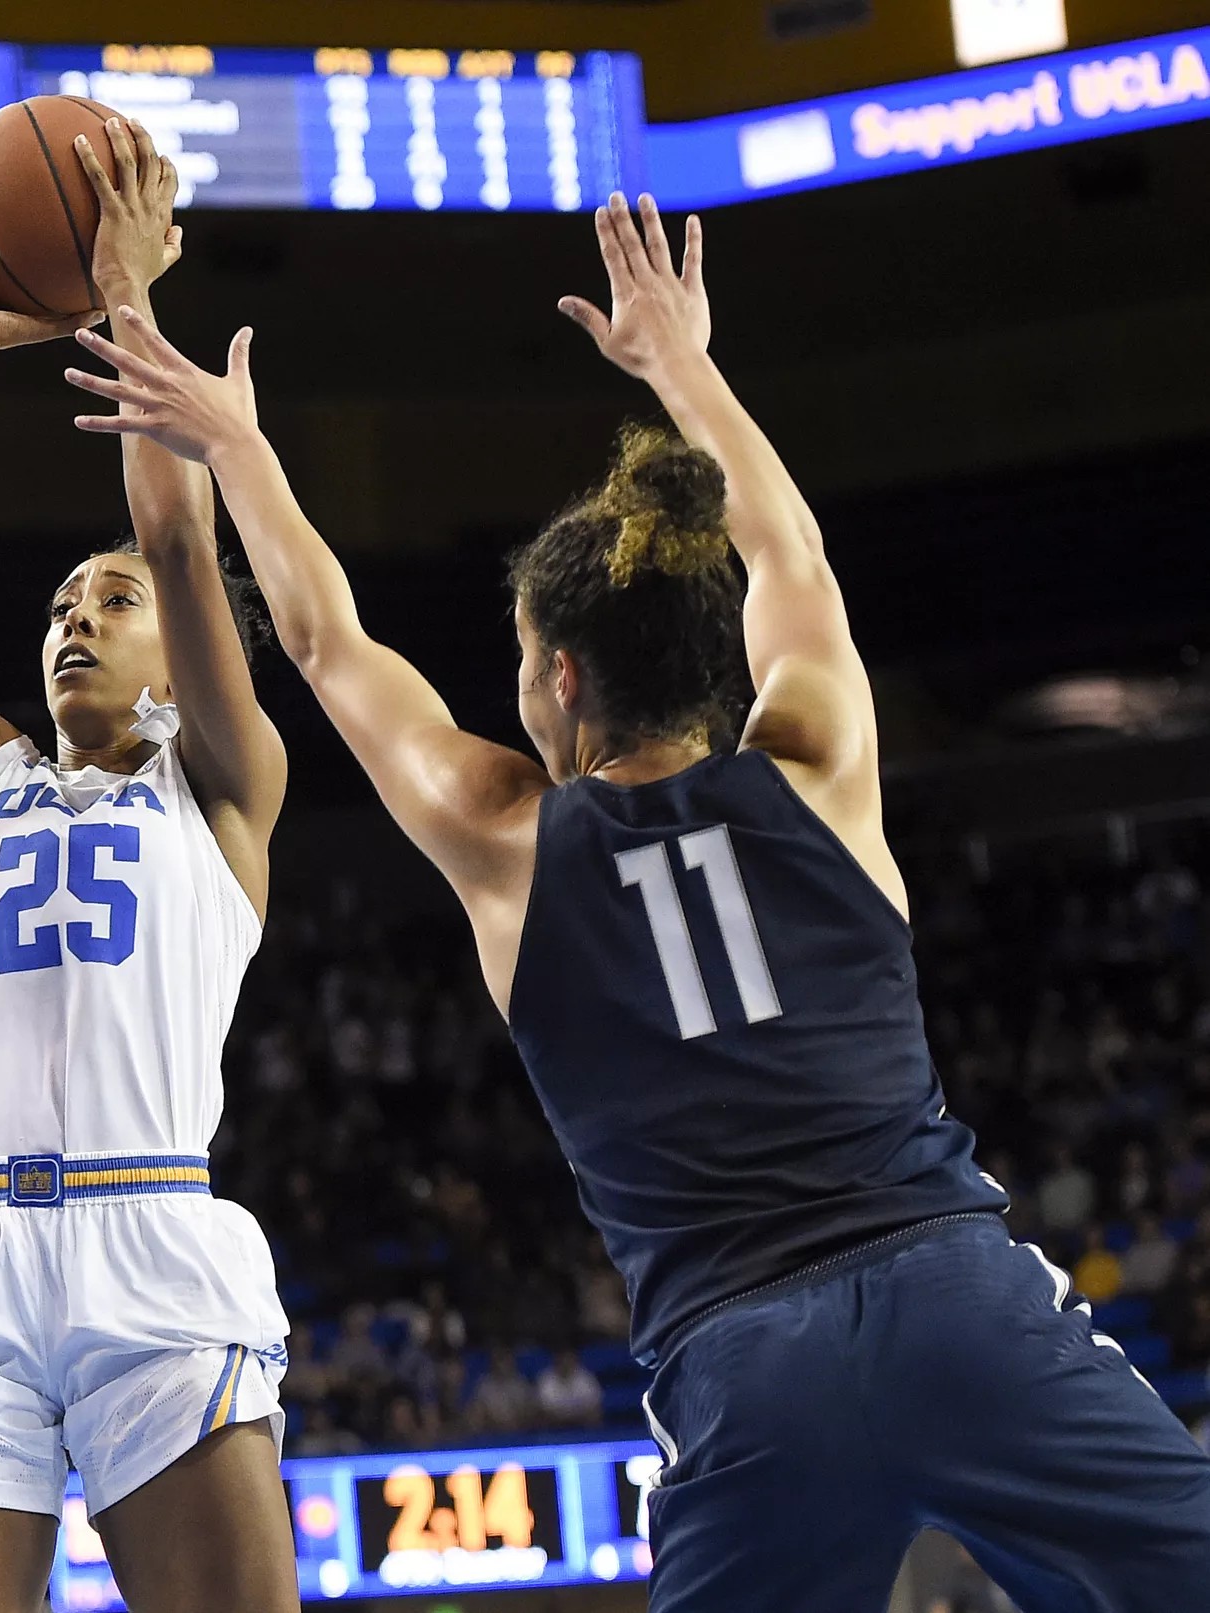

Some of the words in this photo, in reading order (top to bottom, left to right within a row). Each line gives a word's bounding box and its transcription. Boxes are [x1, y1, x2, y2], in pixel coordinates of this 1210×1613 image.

[852, 71, 1063, 158] Support
[1069, 45, 1210, 118] UCLA
[614, 824, 783, 1040] 11
